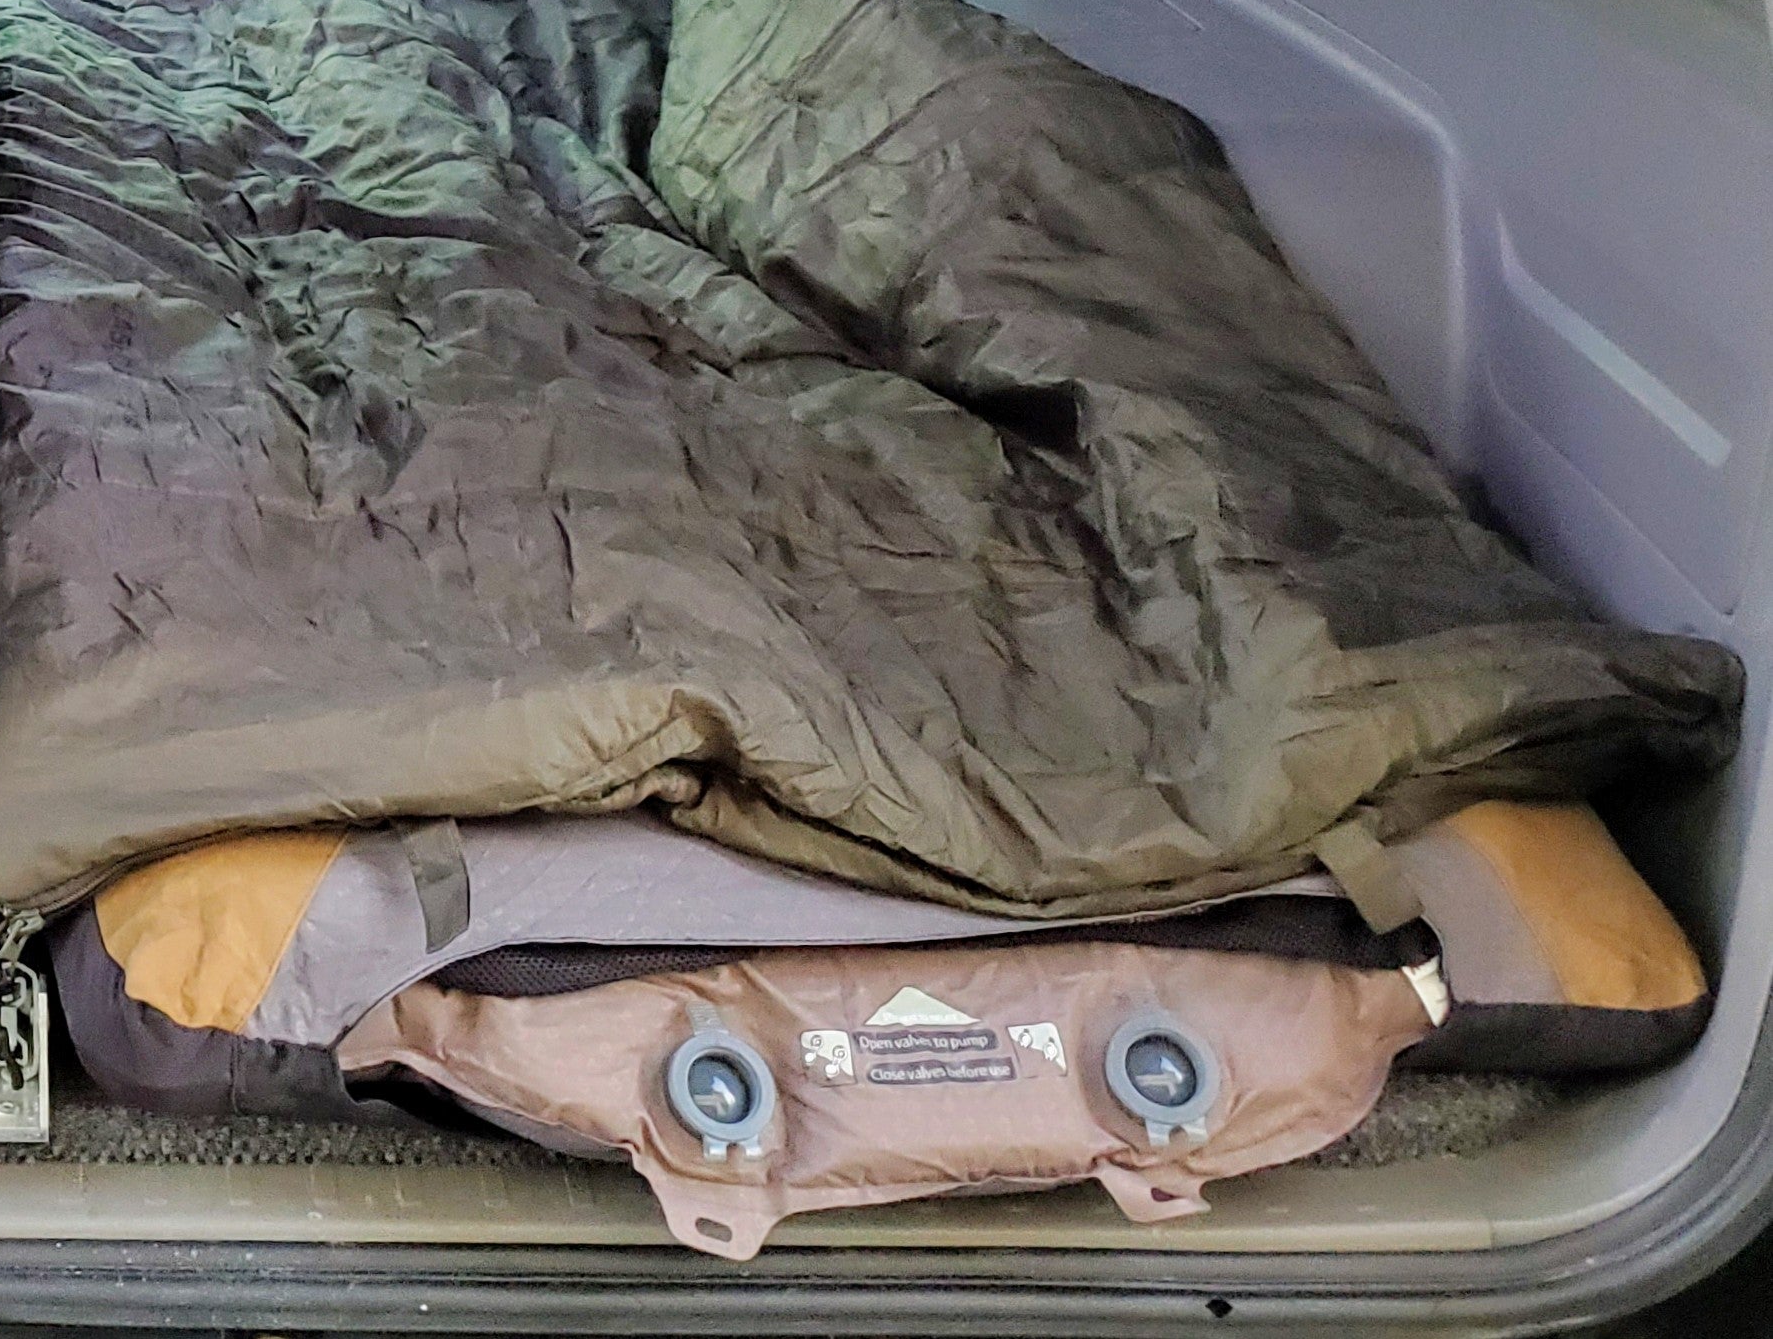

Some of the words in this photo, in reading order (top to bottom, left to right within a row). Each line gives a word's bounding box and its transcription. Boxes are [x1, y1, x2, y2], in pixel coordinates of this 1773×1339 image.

[859, 1035, 894, 1051] Open
[932, 1037, 947, 1048] to
[949, 1036, 989, 1050] pump
[870, 1068, 905, 1081] Close
[906, 1066, 945, 1080] valves
[947, 1065, 988, 1078] before
[988, 1065, 1011, 1076] use
